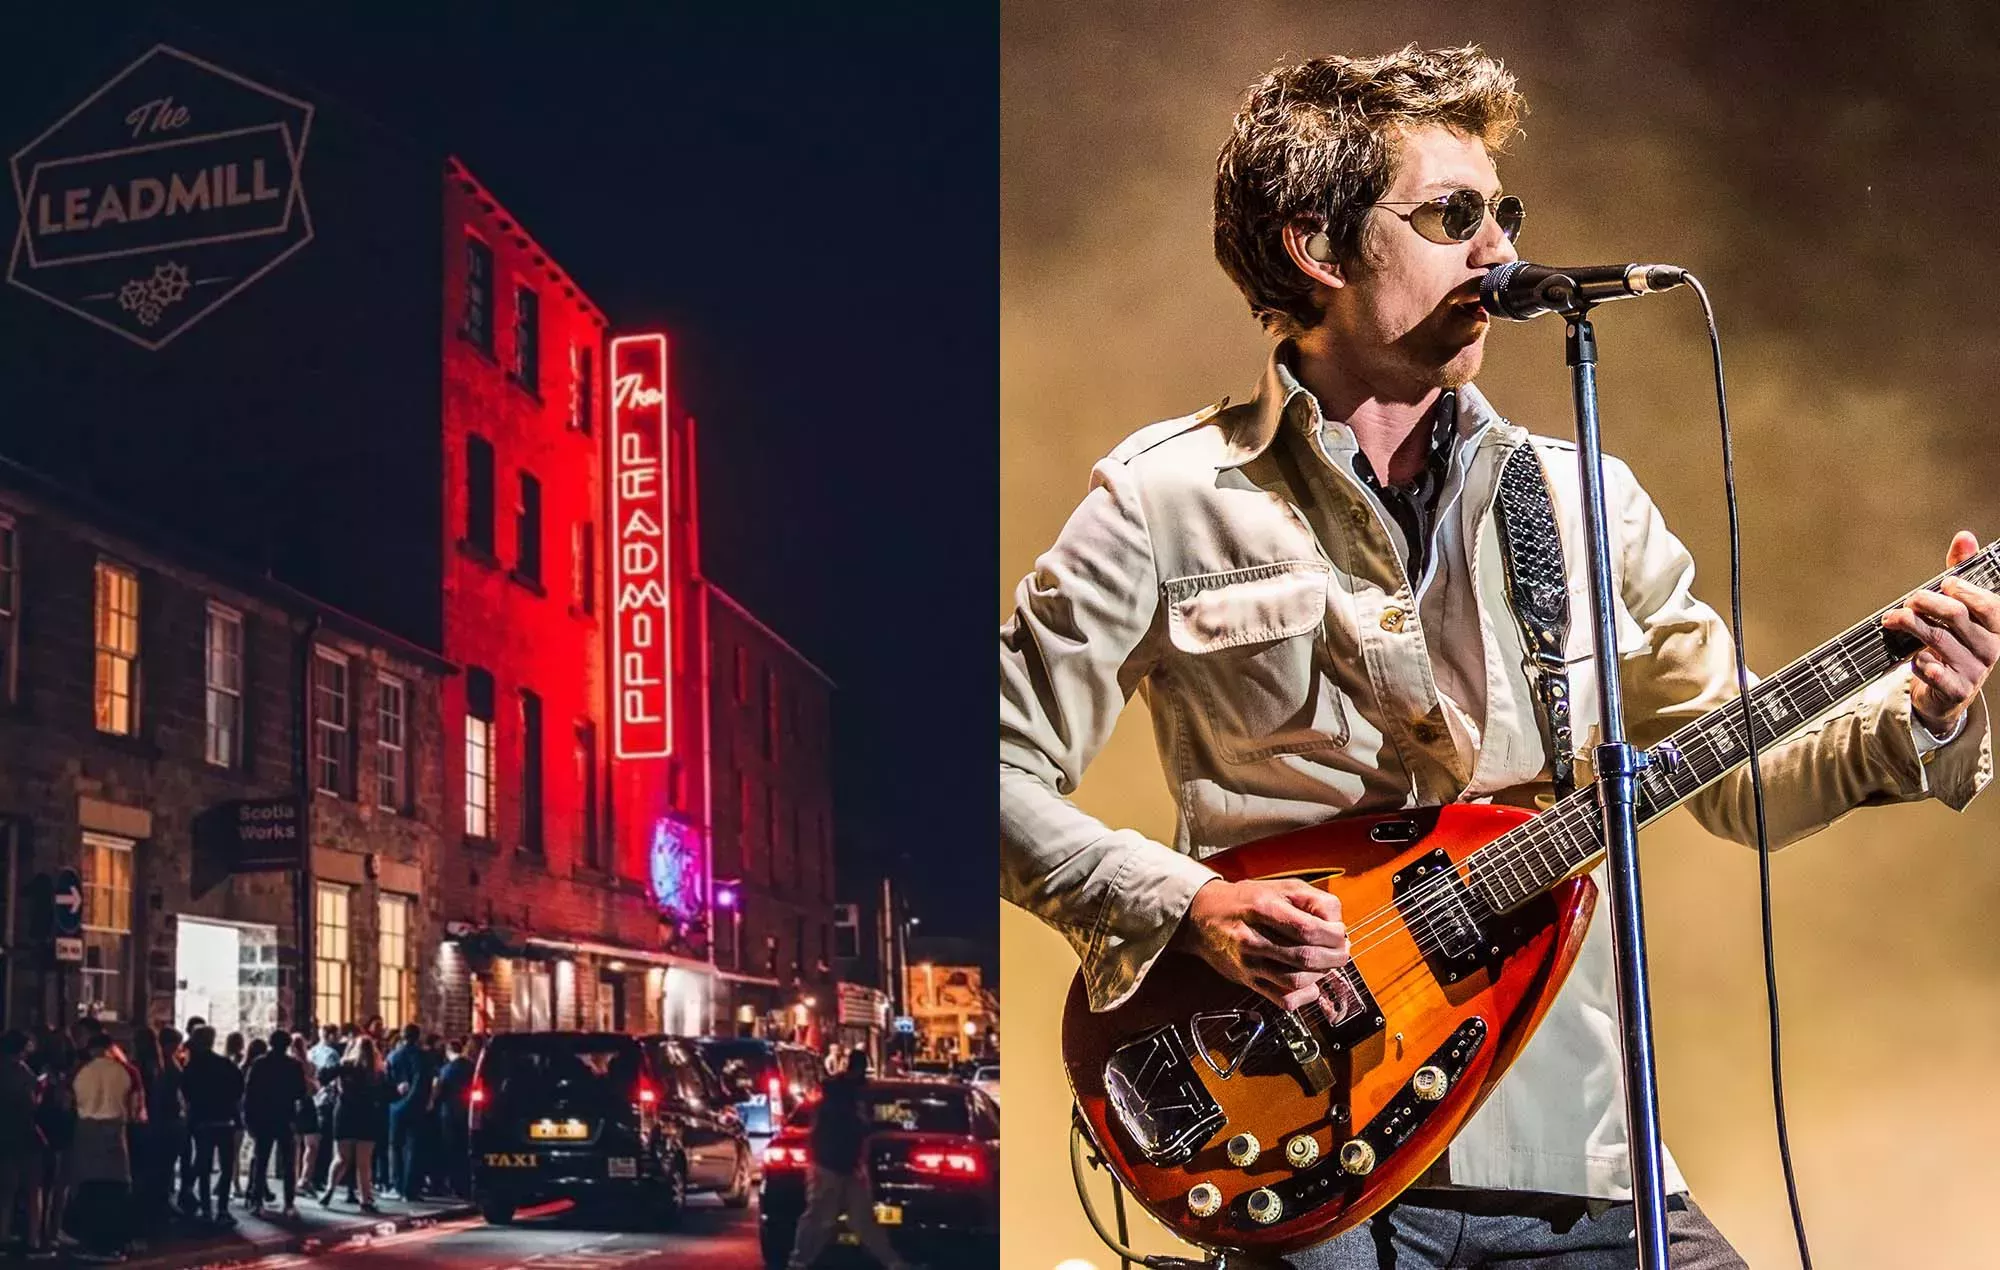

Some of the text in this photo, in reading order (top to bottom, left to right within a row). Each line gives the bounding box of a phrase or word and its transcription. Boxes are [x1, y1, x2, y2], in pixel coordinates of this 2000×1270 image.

[125, 96, 191, 138] The
[38, 158, 280, 235] LEADMILL
[614, 373, 662, 410] The
[239, 804, 295, 820] Scotia
[238, 824, 296, 840] Works
[484, 1153, 538, 1167] TAXI
